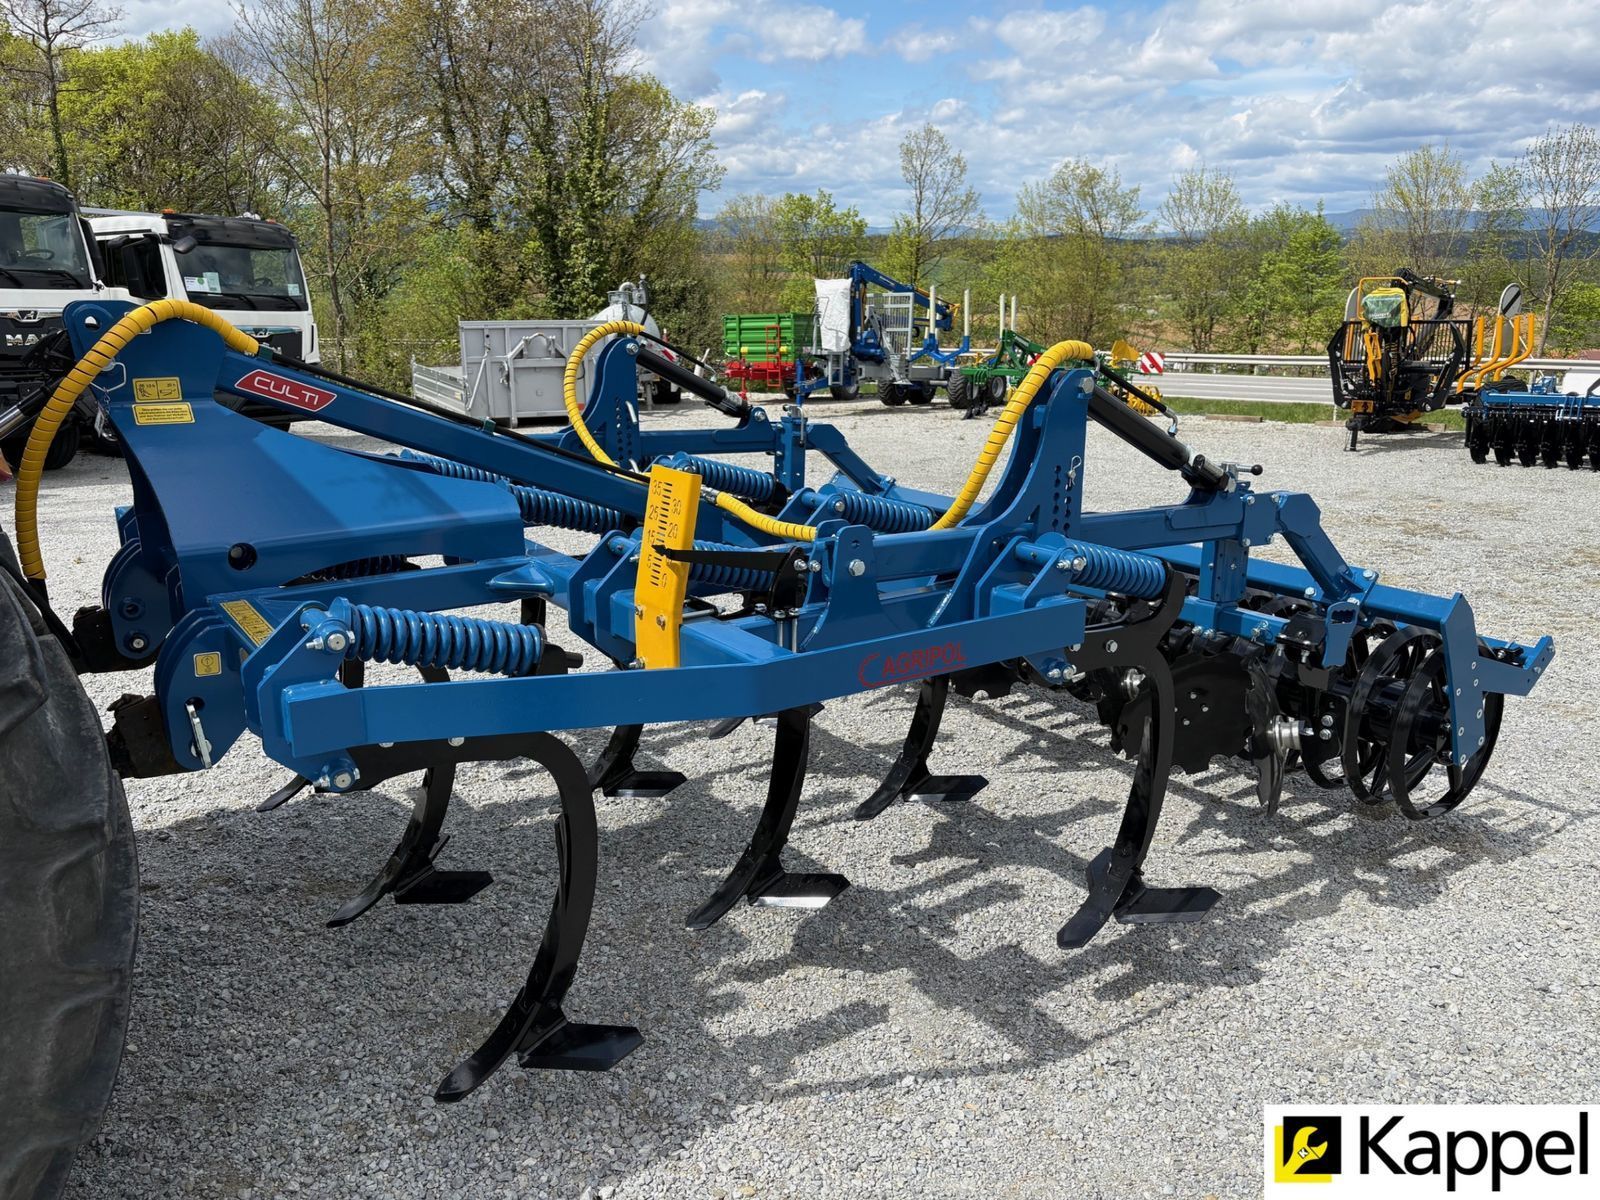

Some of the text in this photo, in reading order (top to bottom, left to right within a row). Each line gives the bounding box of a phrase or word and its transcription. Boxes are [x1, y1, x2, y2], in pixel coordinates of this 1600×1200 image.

[5, 333, 48, 346] MA
[253, 376, 320, 406] CULTI
[651, 480, 662, 496] 35
[648, 504, 659, 520] 25
[667, 522, 678, 539] 20
